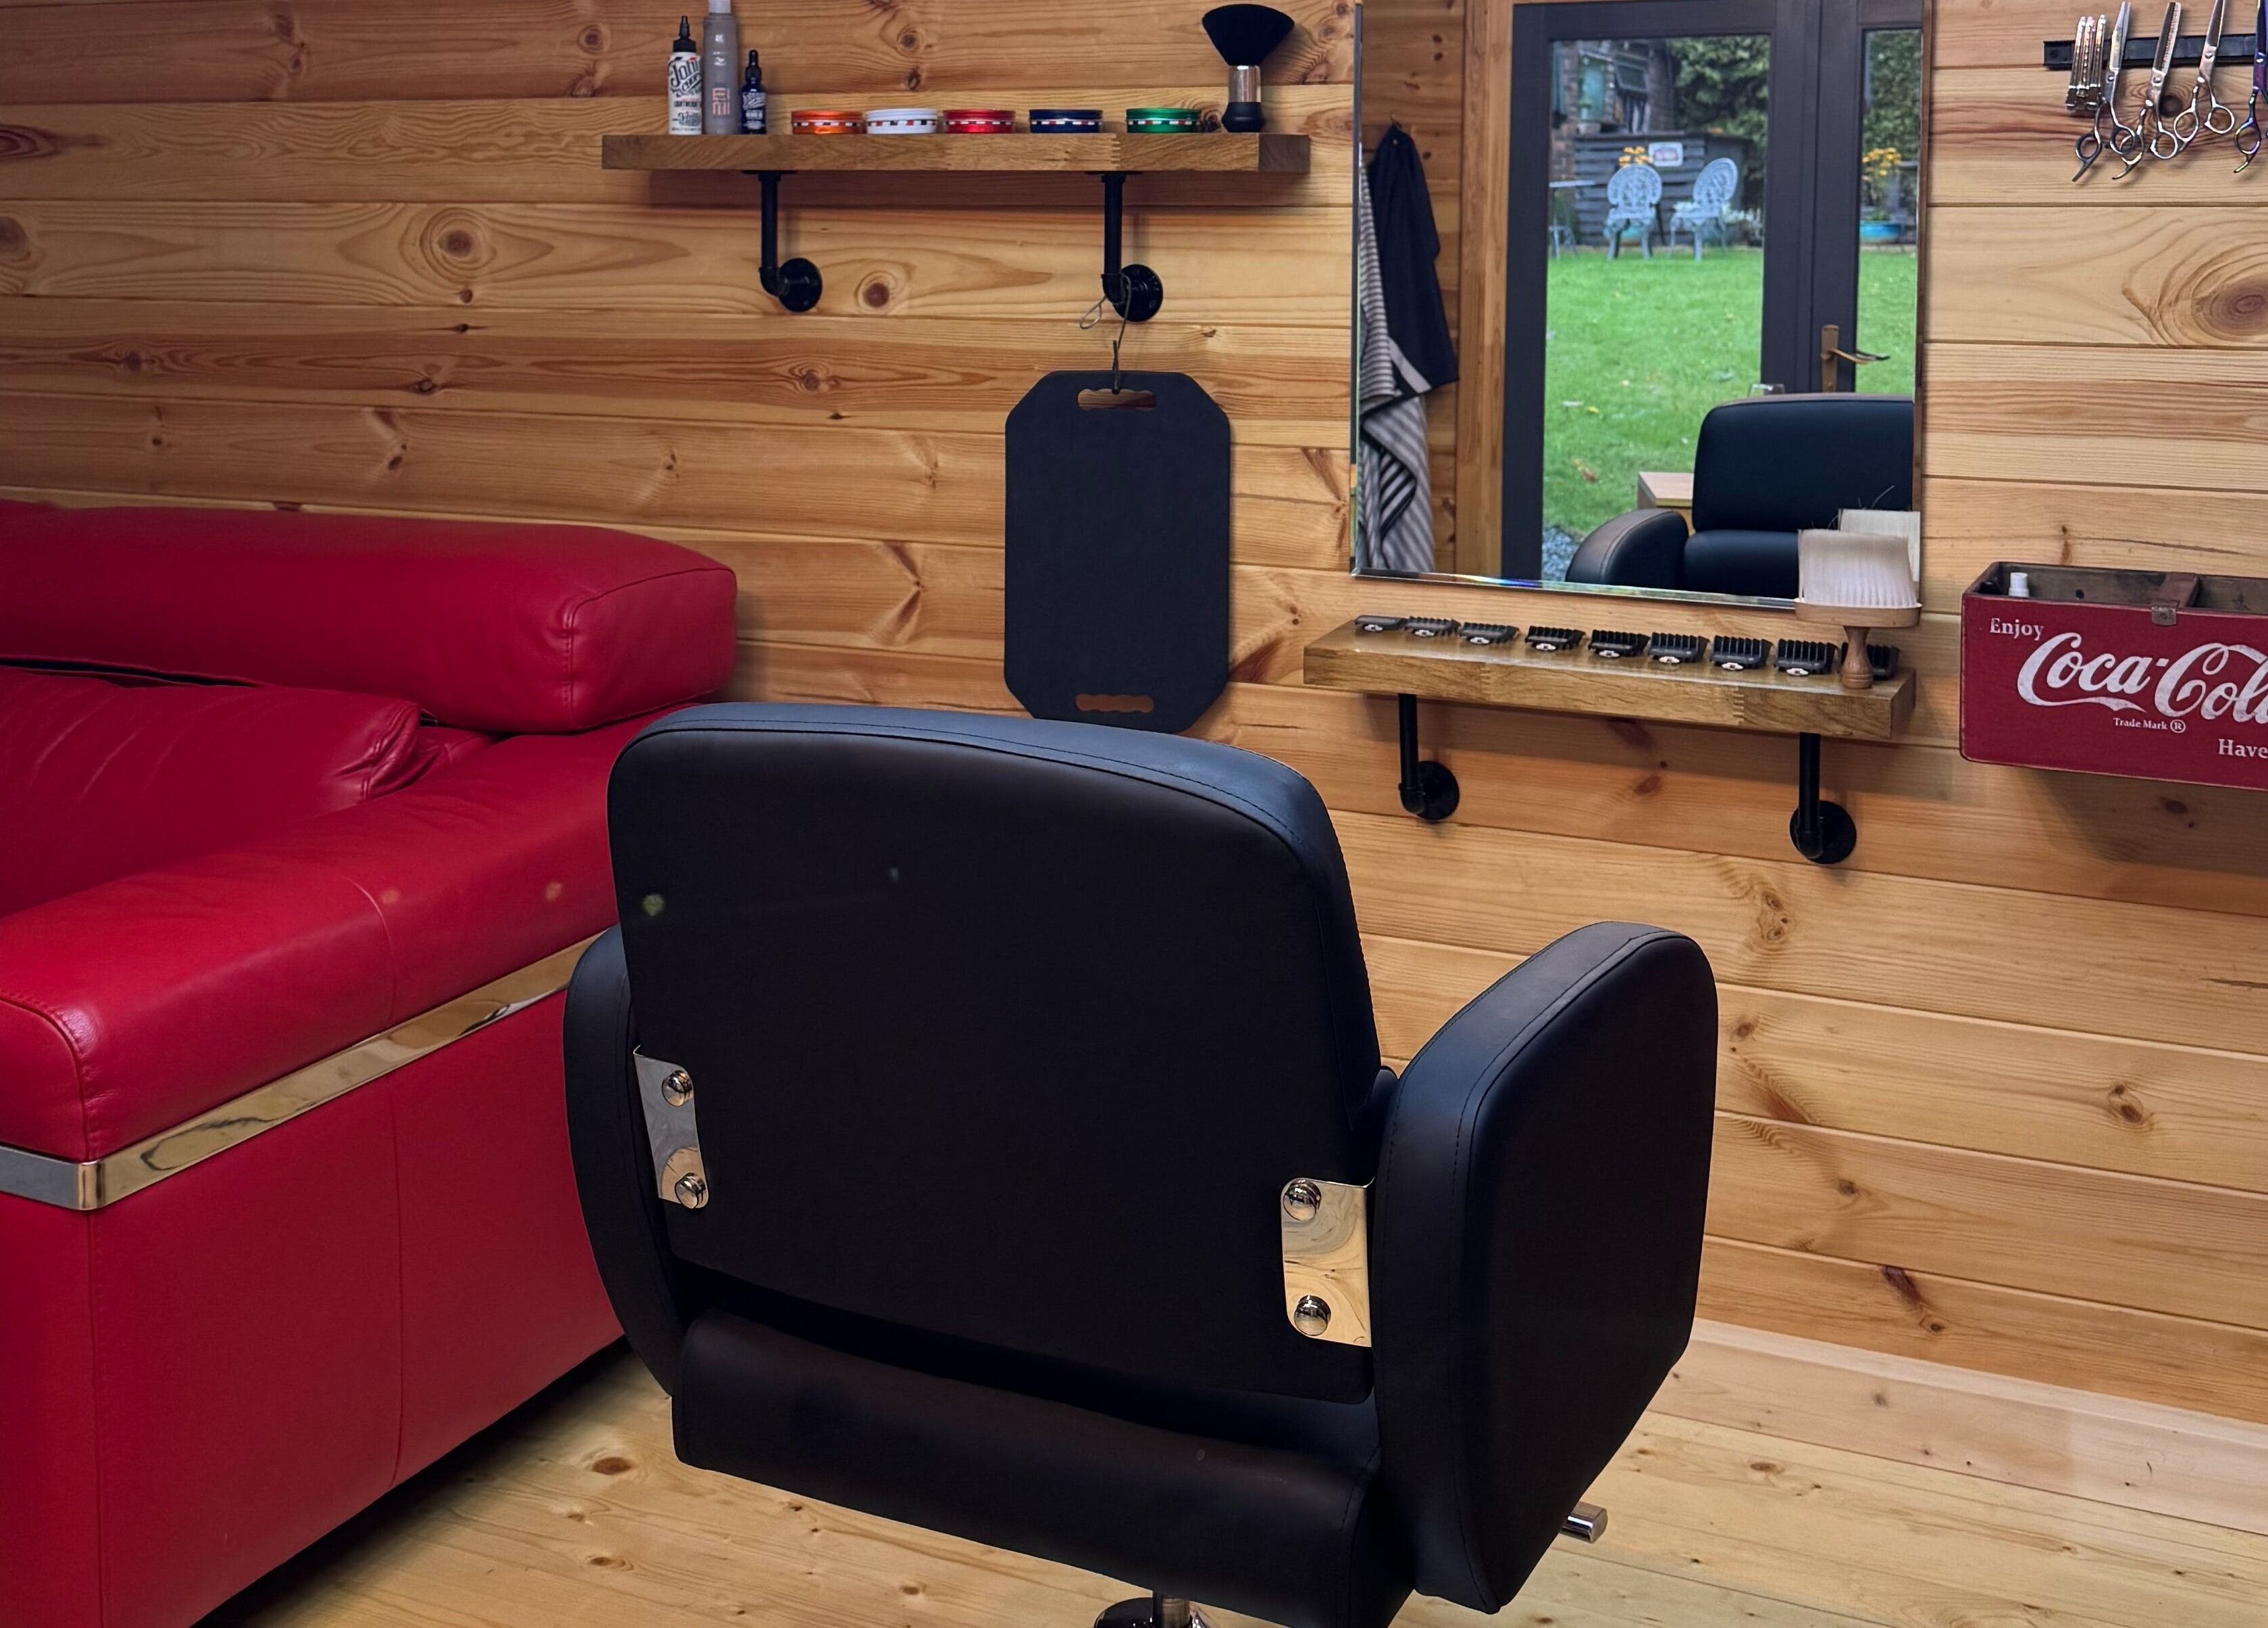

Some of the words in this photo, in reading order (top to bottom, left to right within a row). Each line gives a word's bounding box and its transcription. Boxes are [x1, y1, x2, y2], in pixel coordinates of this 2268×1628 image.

[1989, 617, 2044, 641] Enjoy
[2017, 632, 2268, 724] Coca-Col
[2113, 717, 2141, 728] Trade
[2143, 719, 2168, 730] Mark
[2218, 738, 2268, 759] Have
